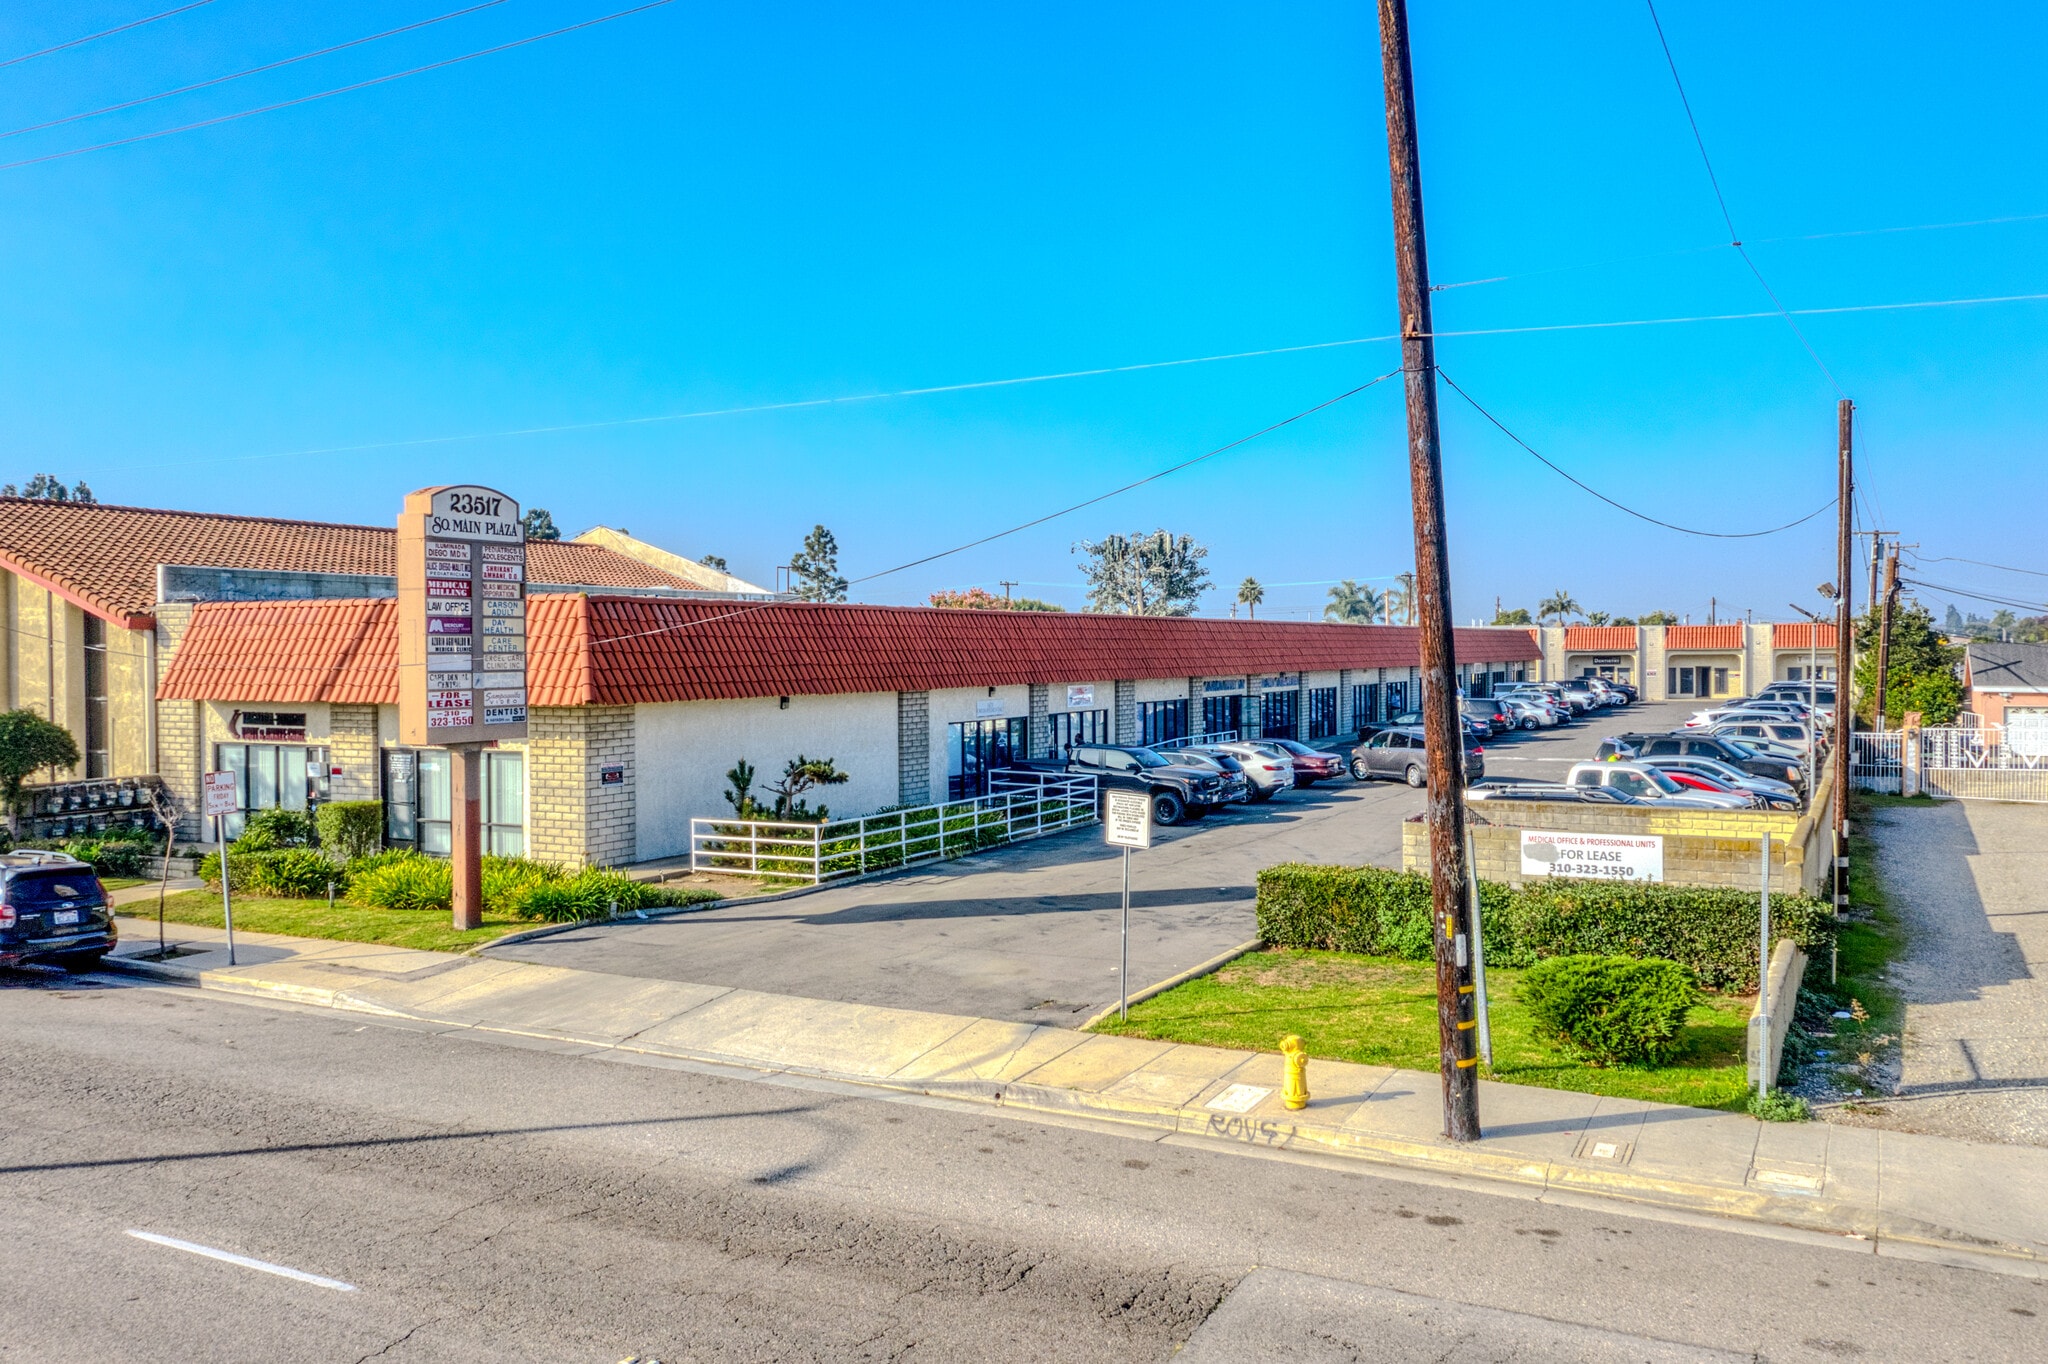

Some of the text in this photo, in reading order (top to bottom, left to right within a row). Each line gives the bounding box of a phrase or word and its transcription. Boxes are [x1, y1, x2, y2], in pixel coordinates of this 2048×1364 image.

[450, 493, 502, 516] 23517
[452, 519, 481, 534] MAIN
[485, 521, 517, 537] PLAZA
[428, 549, 448, 557] DIEGO
[485, 545, 518, 554] PEDIATRICS
[483, 553, 524, 562] ADOLESCENTS
[428, 580, 470, 589] MEDICAL
[430, 588, 467, 597] BILLING
[428, 602, 442, 611] LAW
[488, 601, 518, 609] CARSON
[440, 691, 460, 699] FOR
[428, 699, 472, 708] LEASE
[486, 707, 525, 717] DENTIST
[431, 716, 474, 727] 323-1550
[207, 783, 235, 791] PARKING
[1528, 835, 1656, 849] MEDICAL OFFICE & PROFESSIONAL UNITS
[1560, 849, 1622, 862] FOR LEASE
[1549, 862, 1634, 877] 310-323-1550
